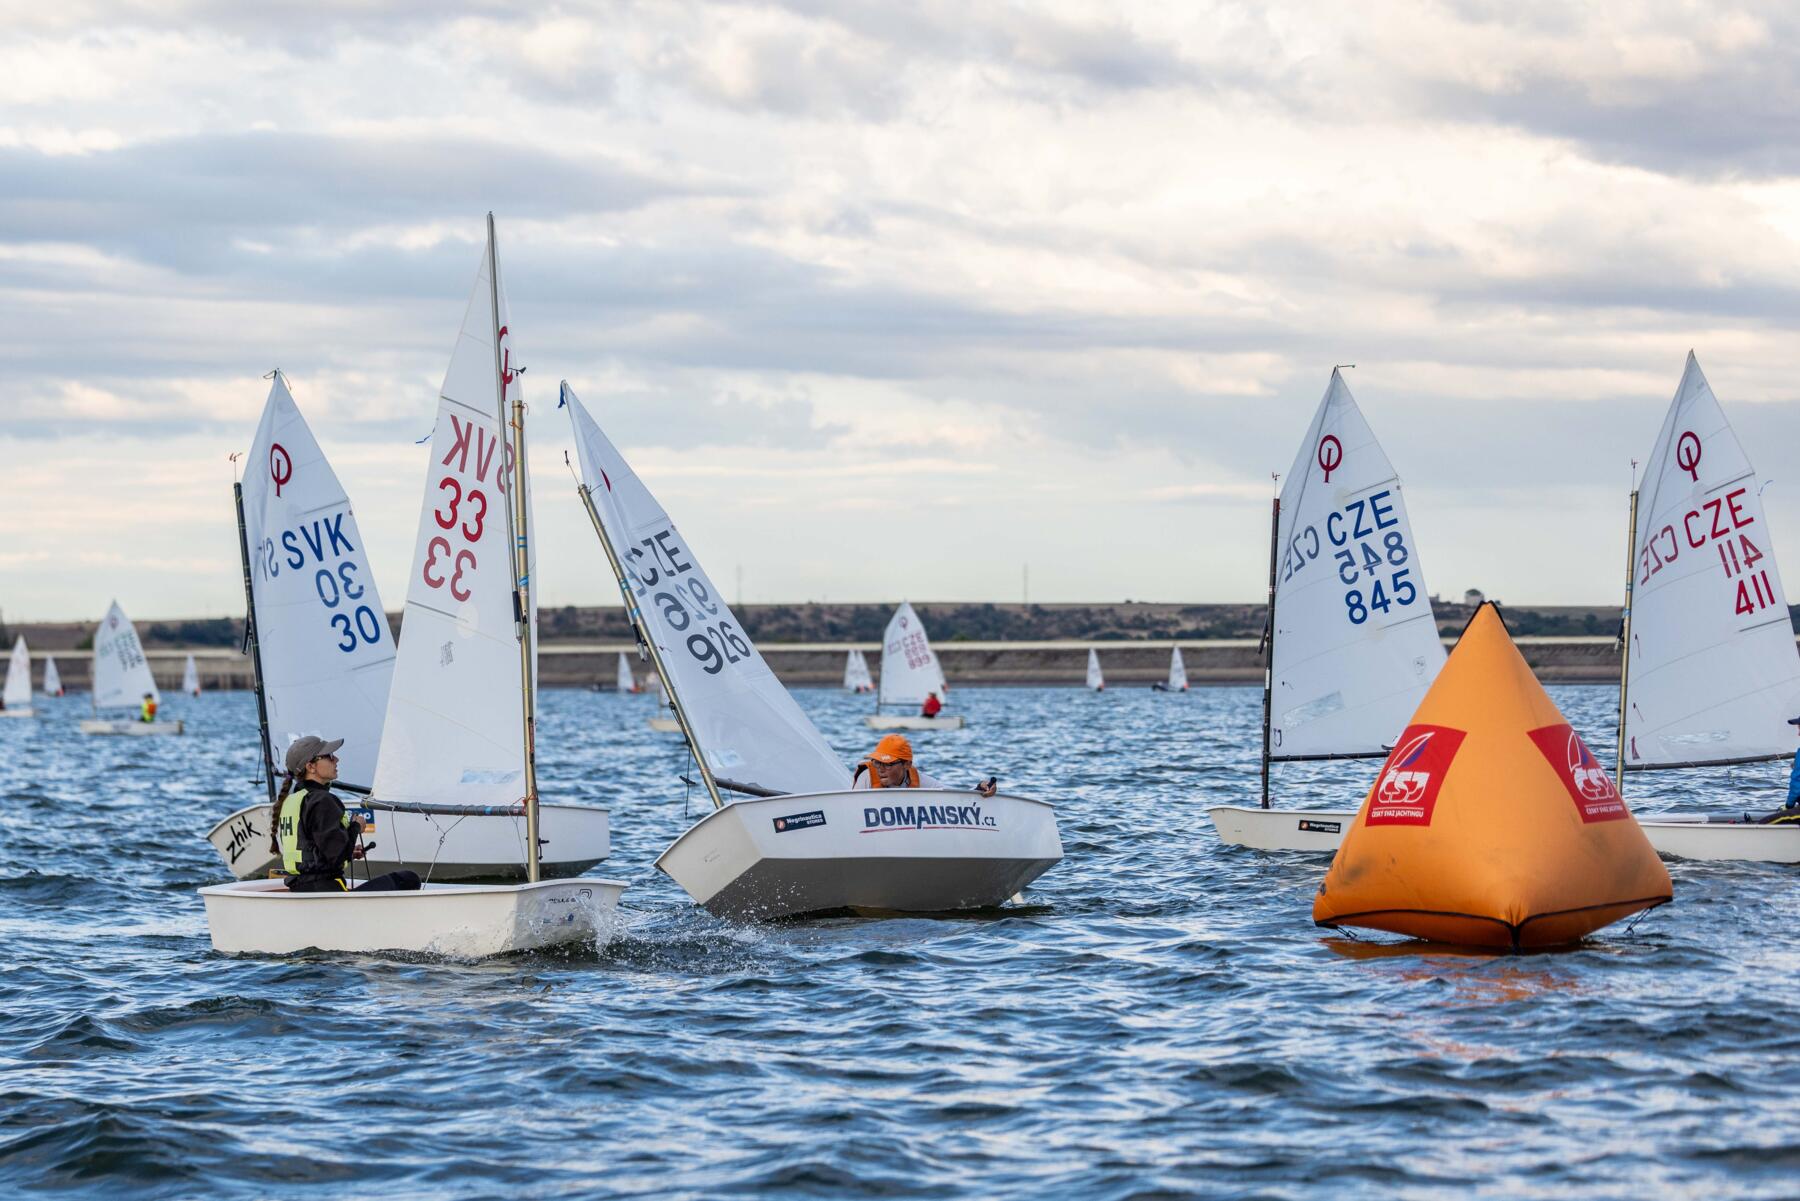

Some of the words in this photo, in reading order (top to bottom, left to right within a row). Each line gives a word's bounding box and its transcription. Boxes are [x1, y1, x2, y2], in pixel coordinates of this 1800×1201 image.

[435, 477, 487, 542] 33
[1327, 490, 1398, 546] CZE
[1684, 488, 1754, 548] CZE
[282, 513, 354, 569] SVK
[1345, 569, 1416, 624] 845
[1736, 570, 1776, 615] 411
[331, 605, 381, 652] 30
[686, 621, 751, 674] 926
